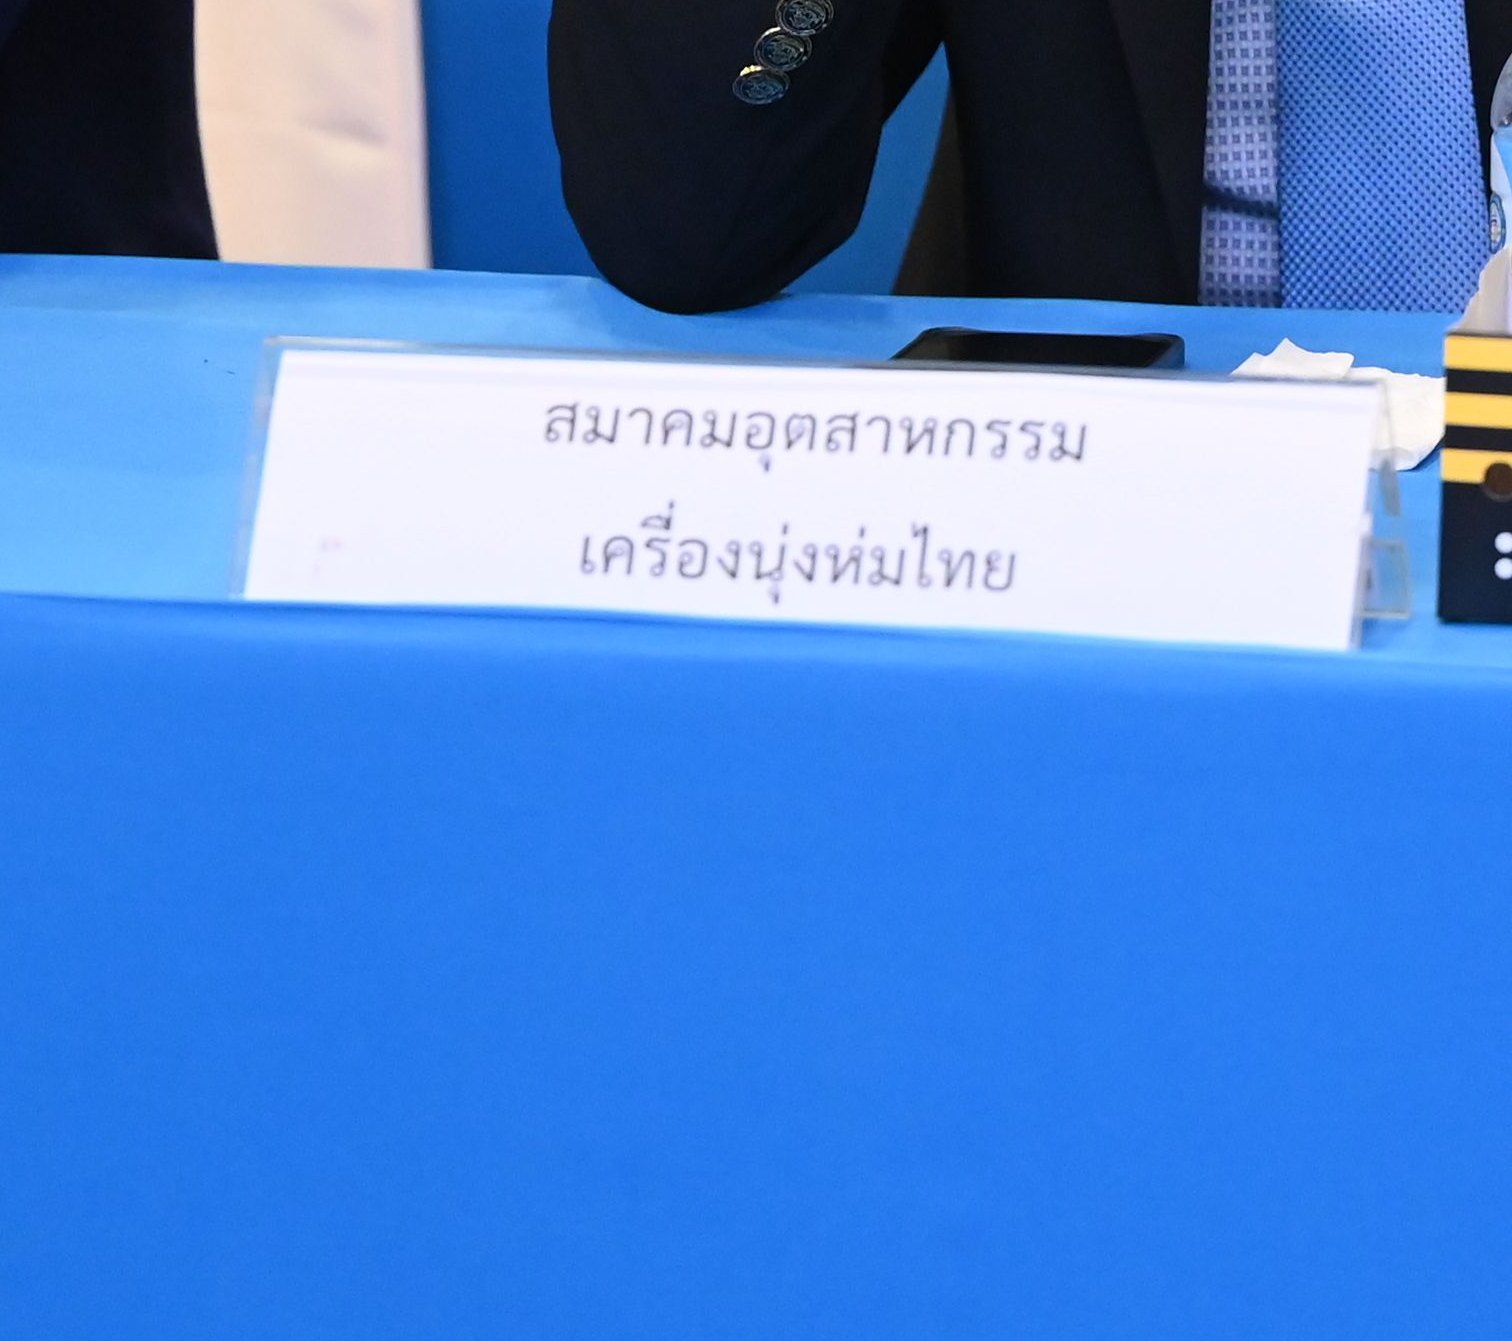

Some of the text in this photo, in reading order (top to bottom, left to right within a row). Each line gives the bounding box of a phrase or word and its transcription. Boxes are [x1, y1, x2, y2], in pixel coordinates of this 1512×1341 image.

[544, 401, 1088, 472] สมาคมอุตสาหกรรม
[578, 500, 1017, 604] เครื่องนุ่งห่มไทย
